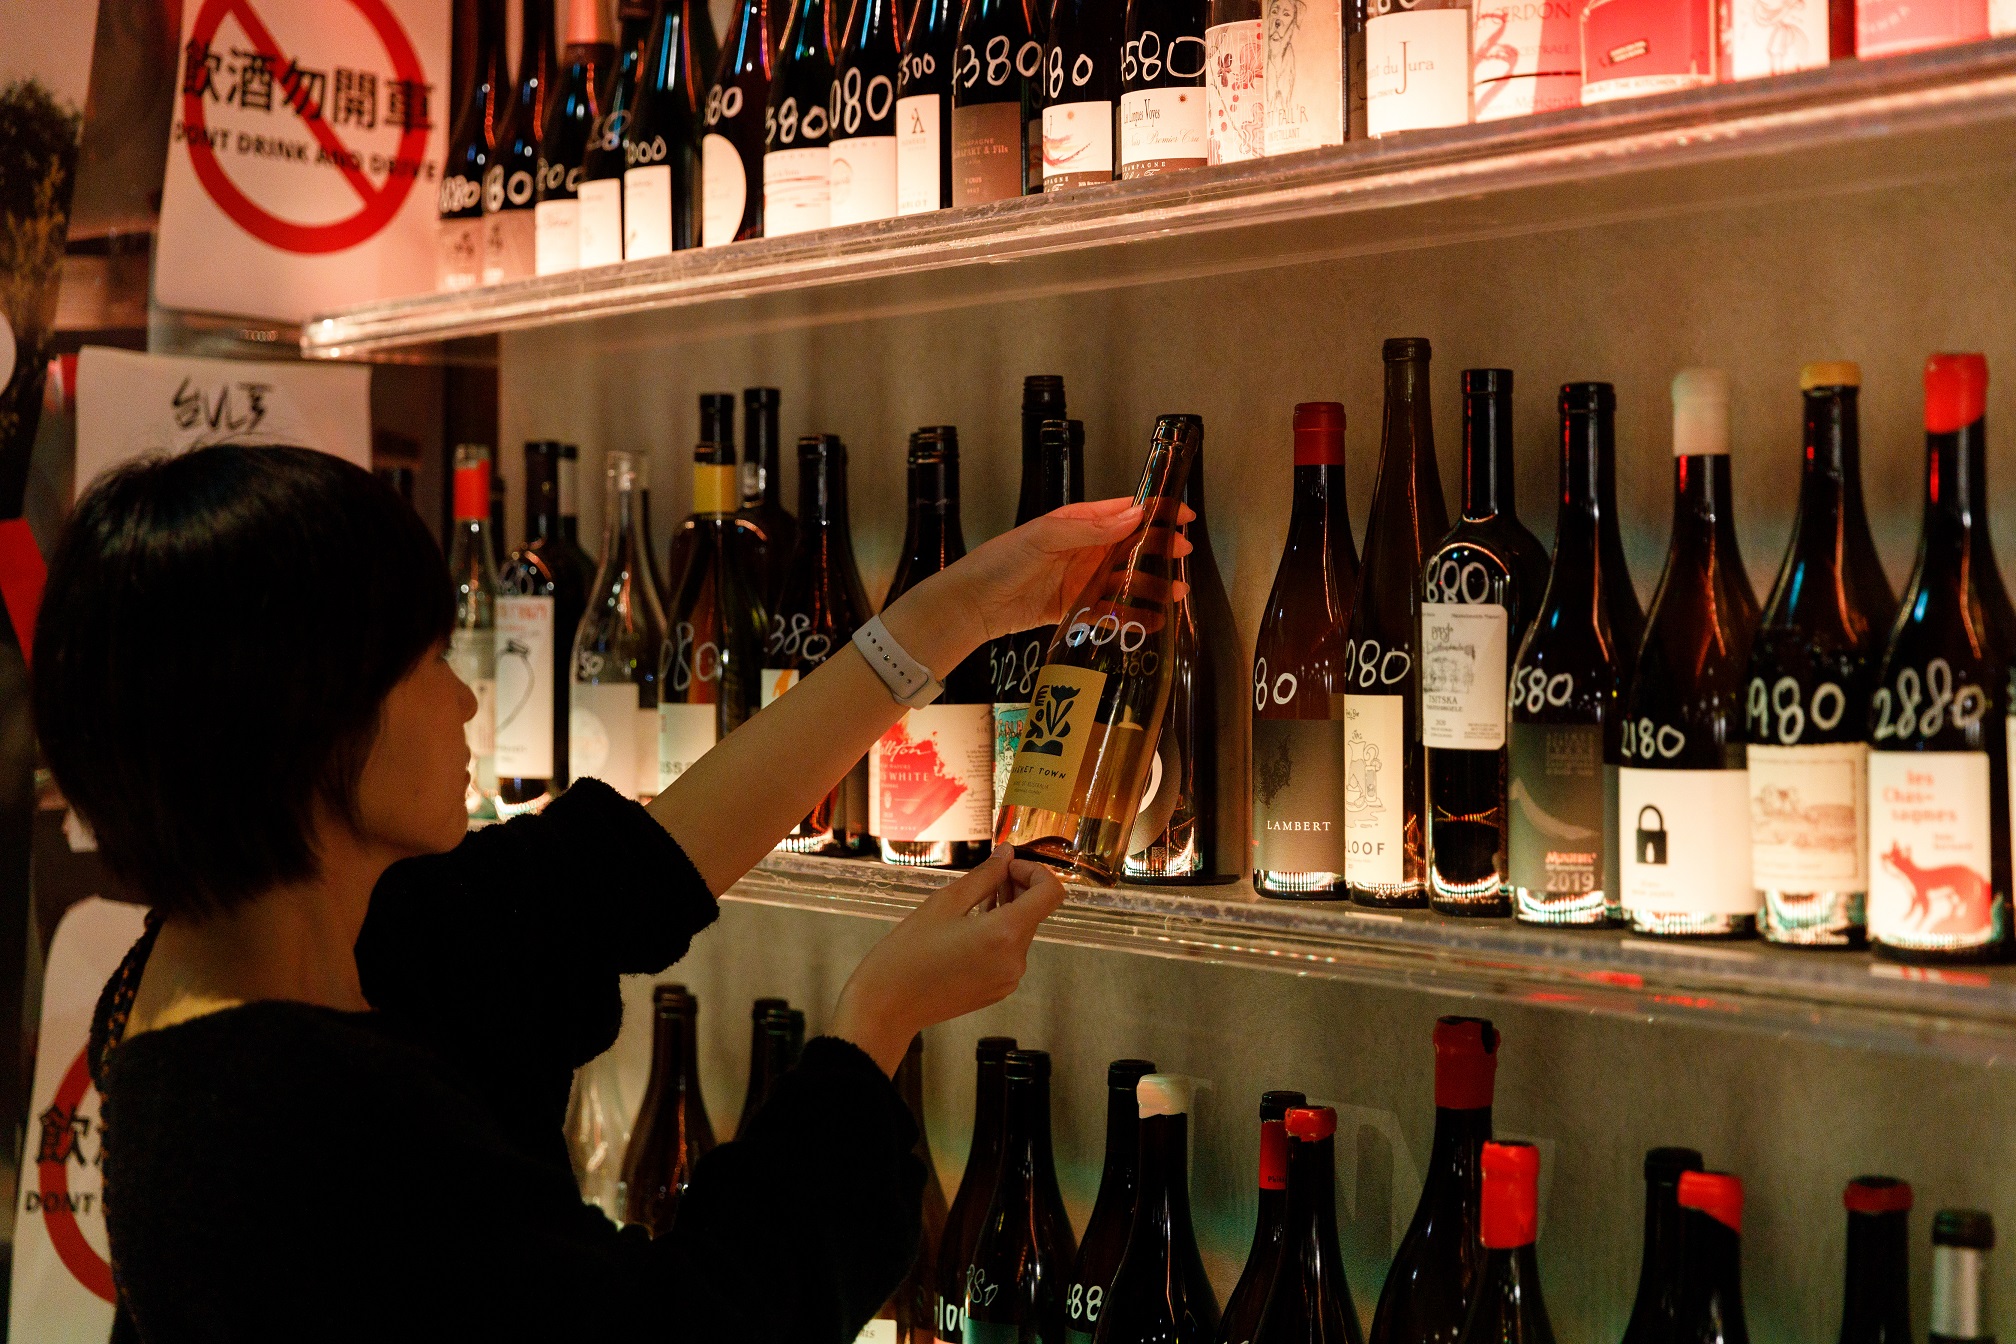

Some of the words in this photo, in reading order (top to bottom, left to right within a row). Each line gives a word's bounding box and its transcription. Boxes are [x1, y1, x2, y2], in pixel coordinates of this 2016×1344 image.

[1383, 56, 1399, 76] du
[1394, 40, 1436, 95] Jura
[184, 38, 434, 134] 飲酒勿開車
[173, 121, 230, 150] DONT
[236, 130, 309, 162] DRINK
[315, 148, 364, 172] AND
[368, 152, 436, 179] DRIVE
[1872, 656, 1988, 741] 2880
[888, 772, 930, 782] WHITE
[1038, 767, 1067, 780] TOWN
[1266, 819, 1332, 832] LAMBERT
[1346, 840, 1386, 857] LOOF
[1546, 873, 1595, 892] 2019
[36, 1103, 104, 1167] 飲
[24, 1190, 97, 1215] DONT
